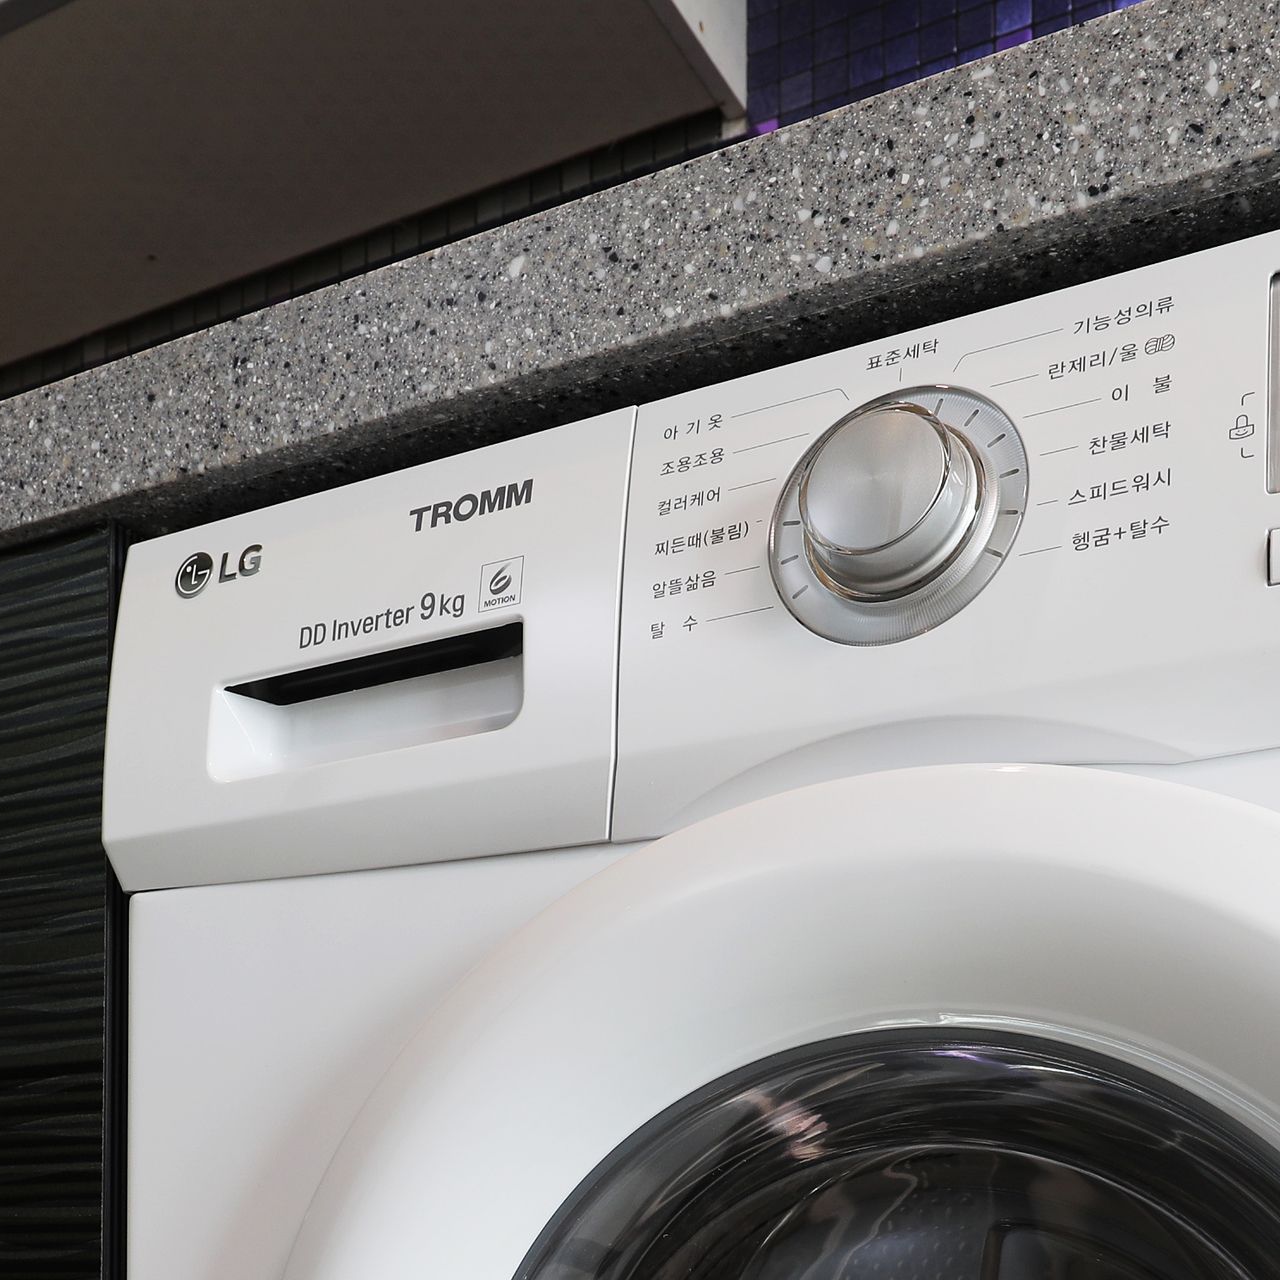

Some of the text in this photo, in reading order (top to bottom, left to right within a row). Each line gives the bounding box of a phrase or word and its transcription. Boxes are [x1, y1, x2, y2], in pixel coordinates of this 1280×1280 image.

[1073, 296, 1175, 335] 기능성의류
[866, 338, 939, 371] 표준세탁
[1048, 343, 1138, 380] 란제리/울
[1089, 421, 1171, 455] 찬물세탁
[660, 447, 724, 475] 조용조용
[409, 478, 534, 532] TROMM
[657, 487, 721, 516] 컬러케어
[1068, 468, 1171, 506] 스피드워시
[655, 520, 749, 556] 찌든때(불림)
[1072, 515, 1170, 552] 헹굼+탈수
[218, 544, 263, 583] LG
[483, 593, 516, 608] MOTION
[652, 570, 716, 599] 알뜰삶음
[299, 623, 327, 649] DD
[332, 606, 414, 641] Inverter
